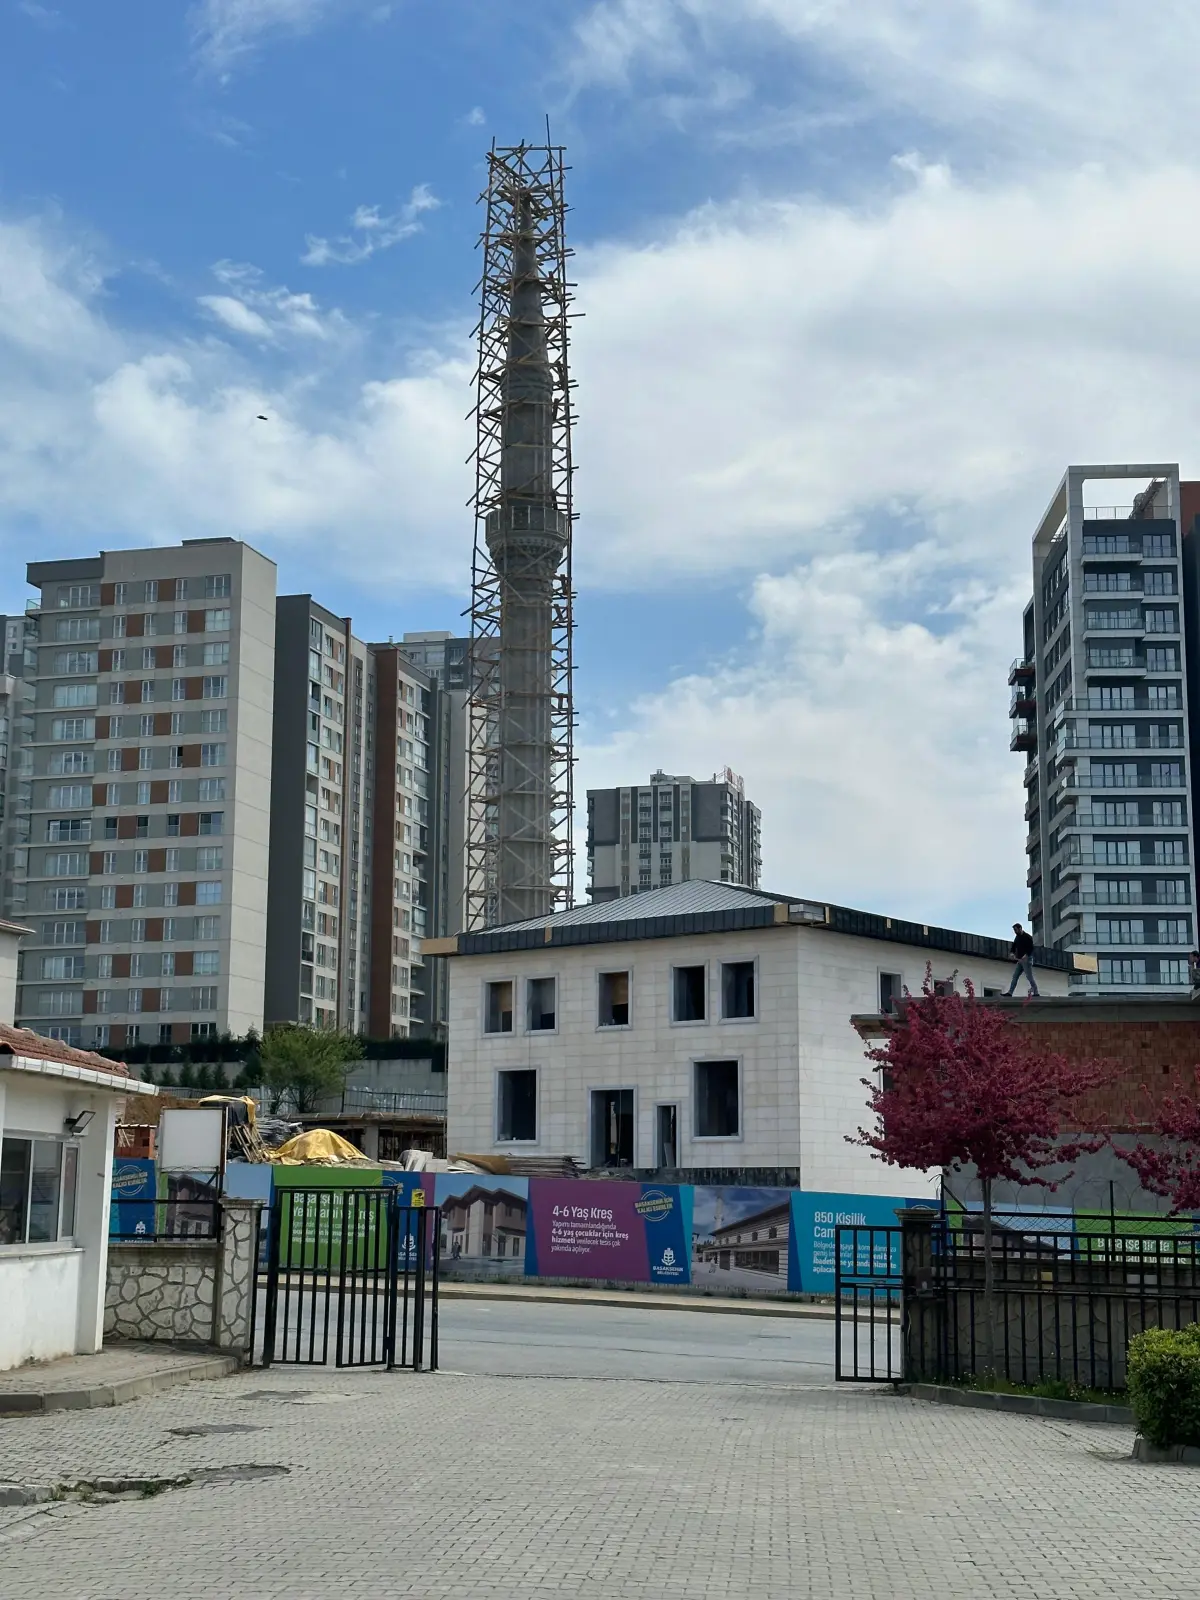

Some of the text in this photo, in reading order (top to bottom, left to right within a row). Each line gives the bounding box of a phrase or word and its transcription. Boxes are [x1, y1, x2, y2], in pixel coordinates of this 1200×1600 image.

[552, 1205, 612, 1222] 4-6 Yaş Kreş
[814, 1211, 866, 1225] 850 Kişilik
[552, 1236, 575, 1244] hizmeti
[602, 1230, 614, 1239] için
[615, 1231, 629, 1240] kreş
